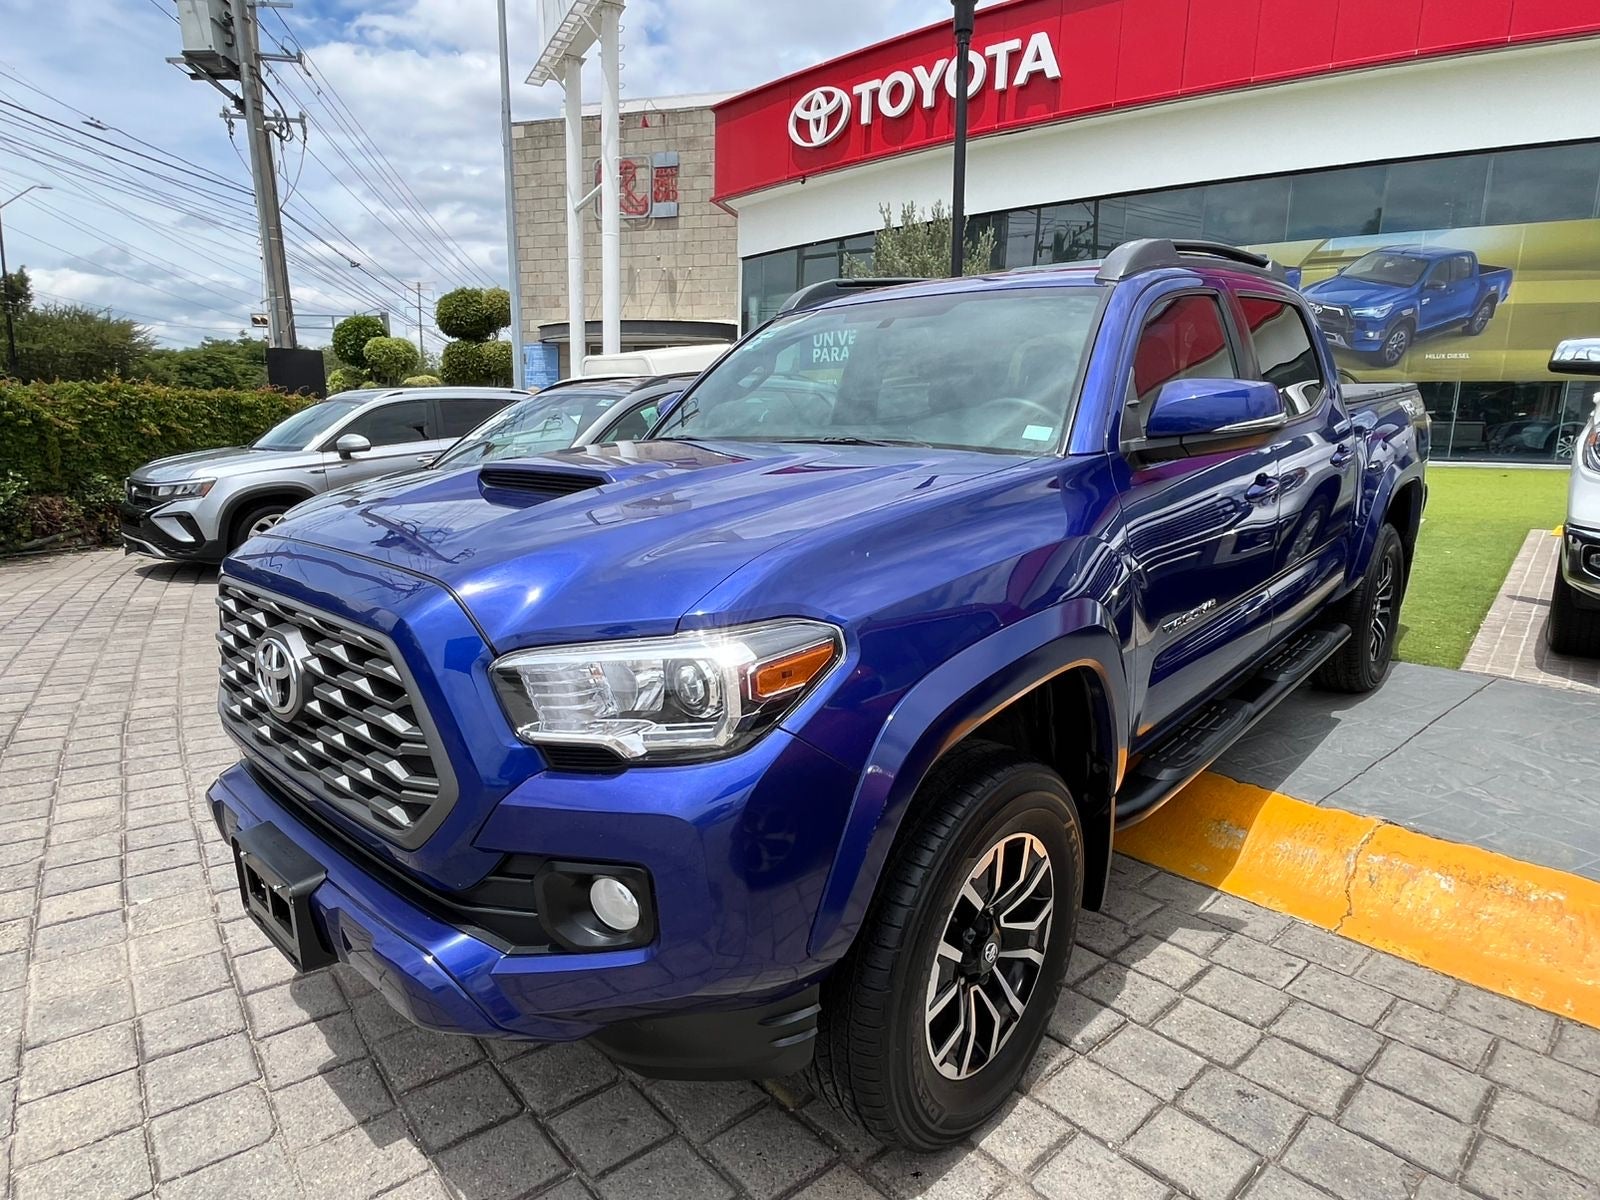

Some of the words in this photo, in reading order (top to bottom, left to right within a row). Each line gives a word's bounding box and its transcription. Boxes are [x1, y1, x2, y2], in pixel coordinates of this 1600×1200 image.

[853, 31, 1061, 126] TOYOTA
[813, 331, 834, 348] UN
[812, 345, 849, 363] PARA
[1161, 598, 1217, 634] TACOMA
